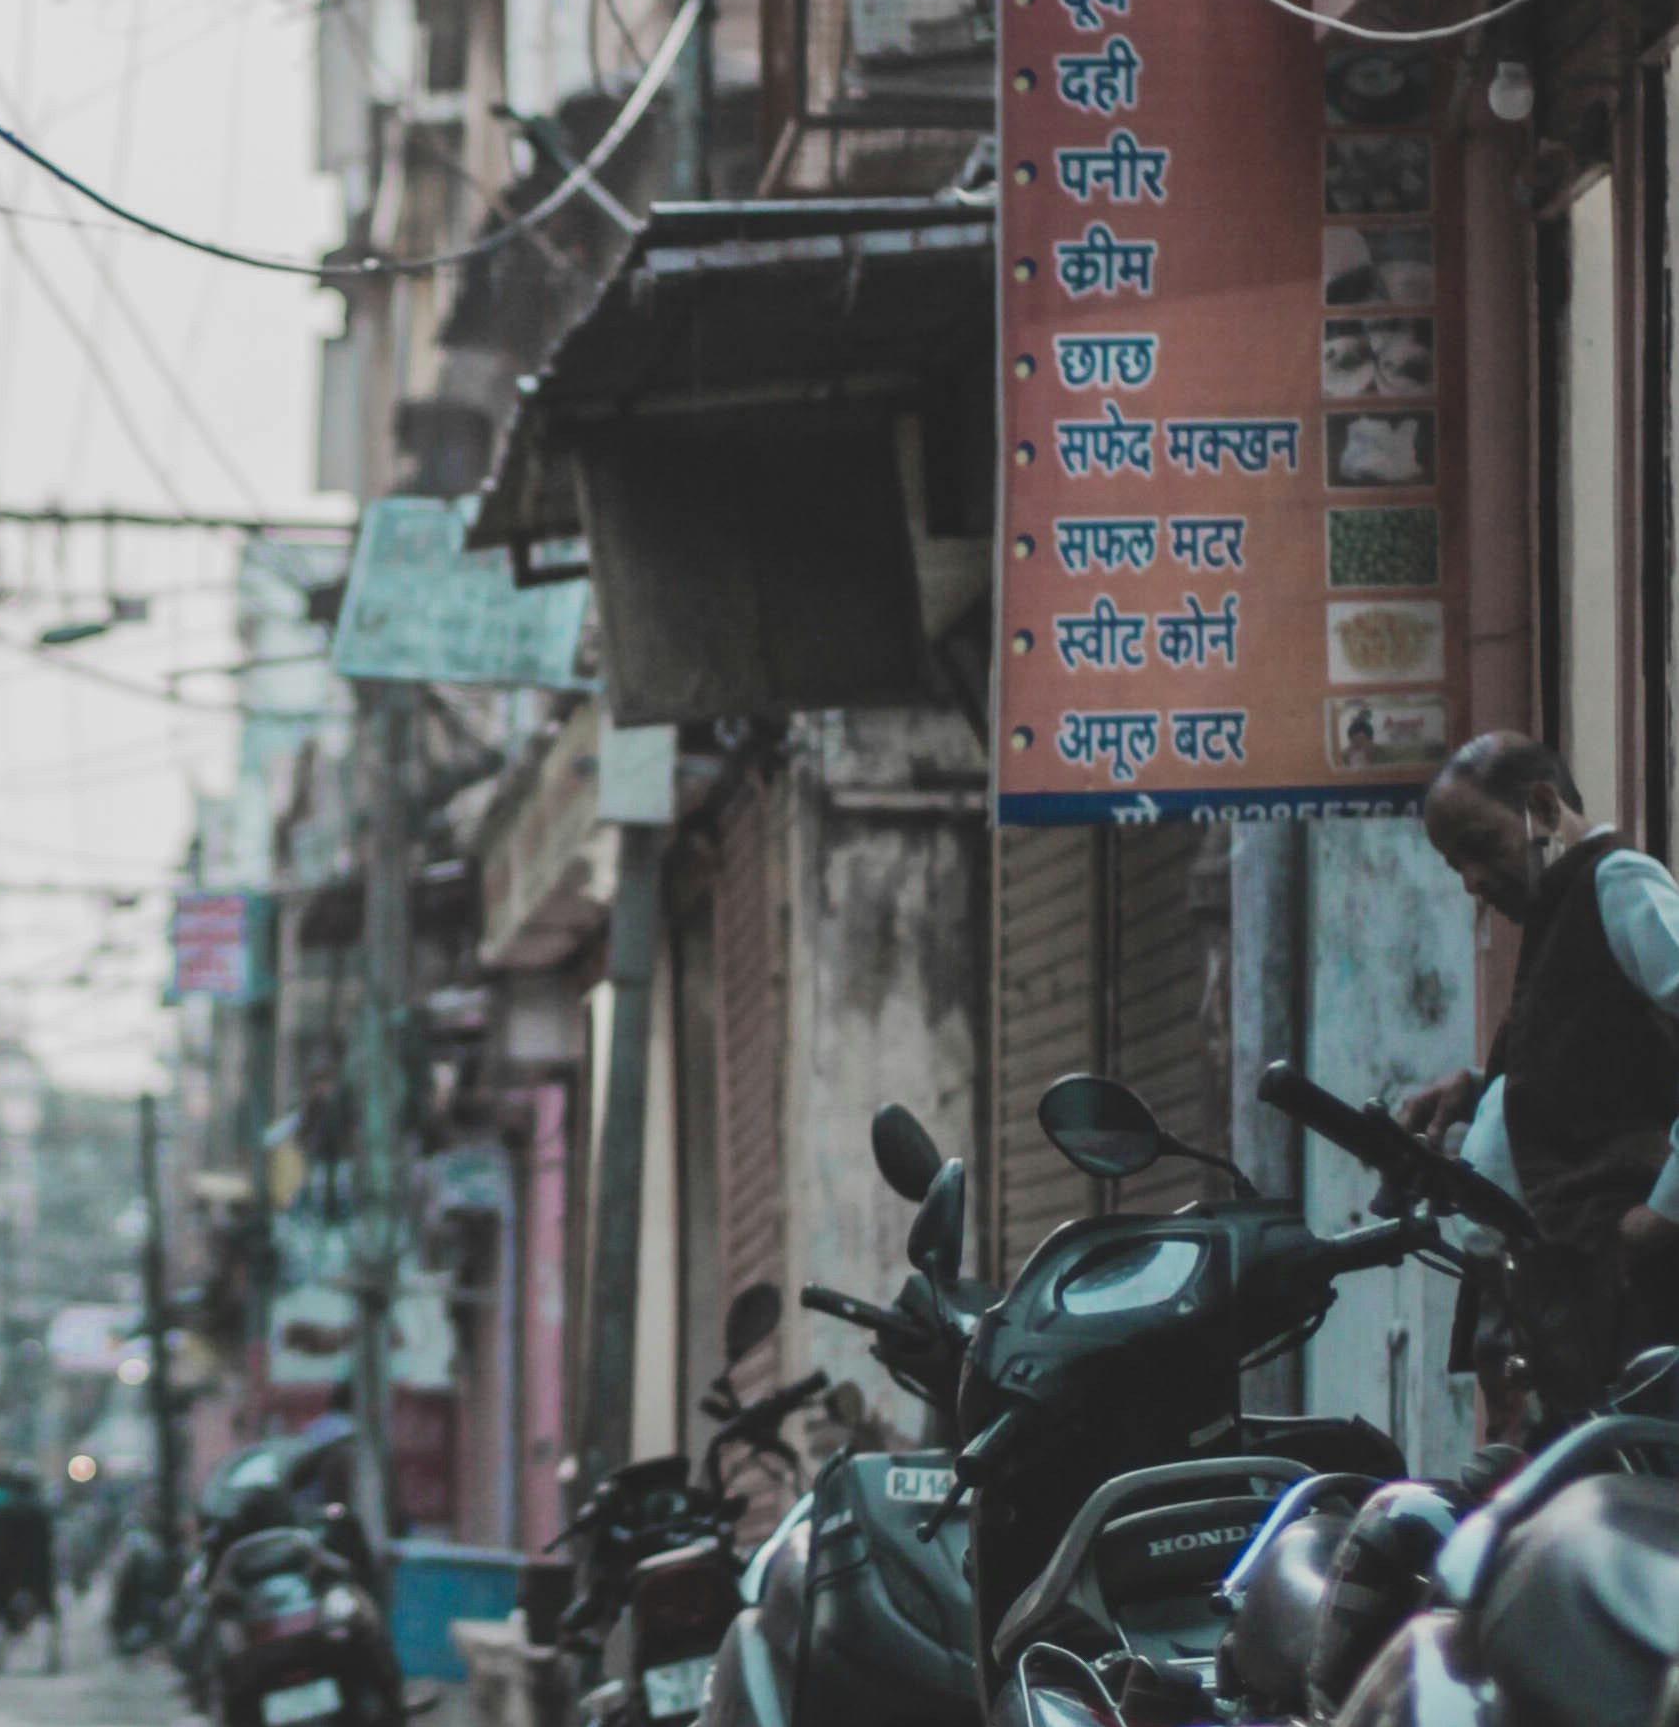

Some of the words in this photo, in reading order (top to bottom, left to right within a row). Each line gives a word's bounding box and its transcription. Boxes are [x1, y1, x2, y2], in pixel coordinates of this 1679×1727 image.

[1057, 36, 1140, 113] दही
[1057, 130, 1168, 202] पनीर
[1056, 336, 1155, 388] छाछ
[1056, 401, 1154, 474] सफेद
[1167, 420, 1300, 473] मक्खन
[1056, 518, 1157, 570] सफल
[1170, 517, 1246, 570] मटर
[1056, 596, 1147, 669] स्वीट
[1156, 594, 1238, 666] कोर्न
[1058, 711, 1160, 780] अमूल
[1171, 710, 1246, 762] बटर
